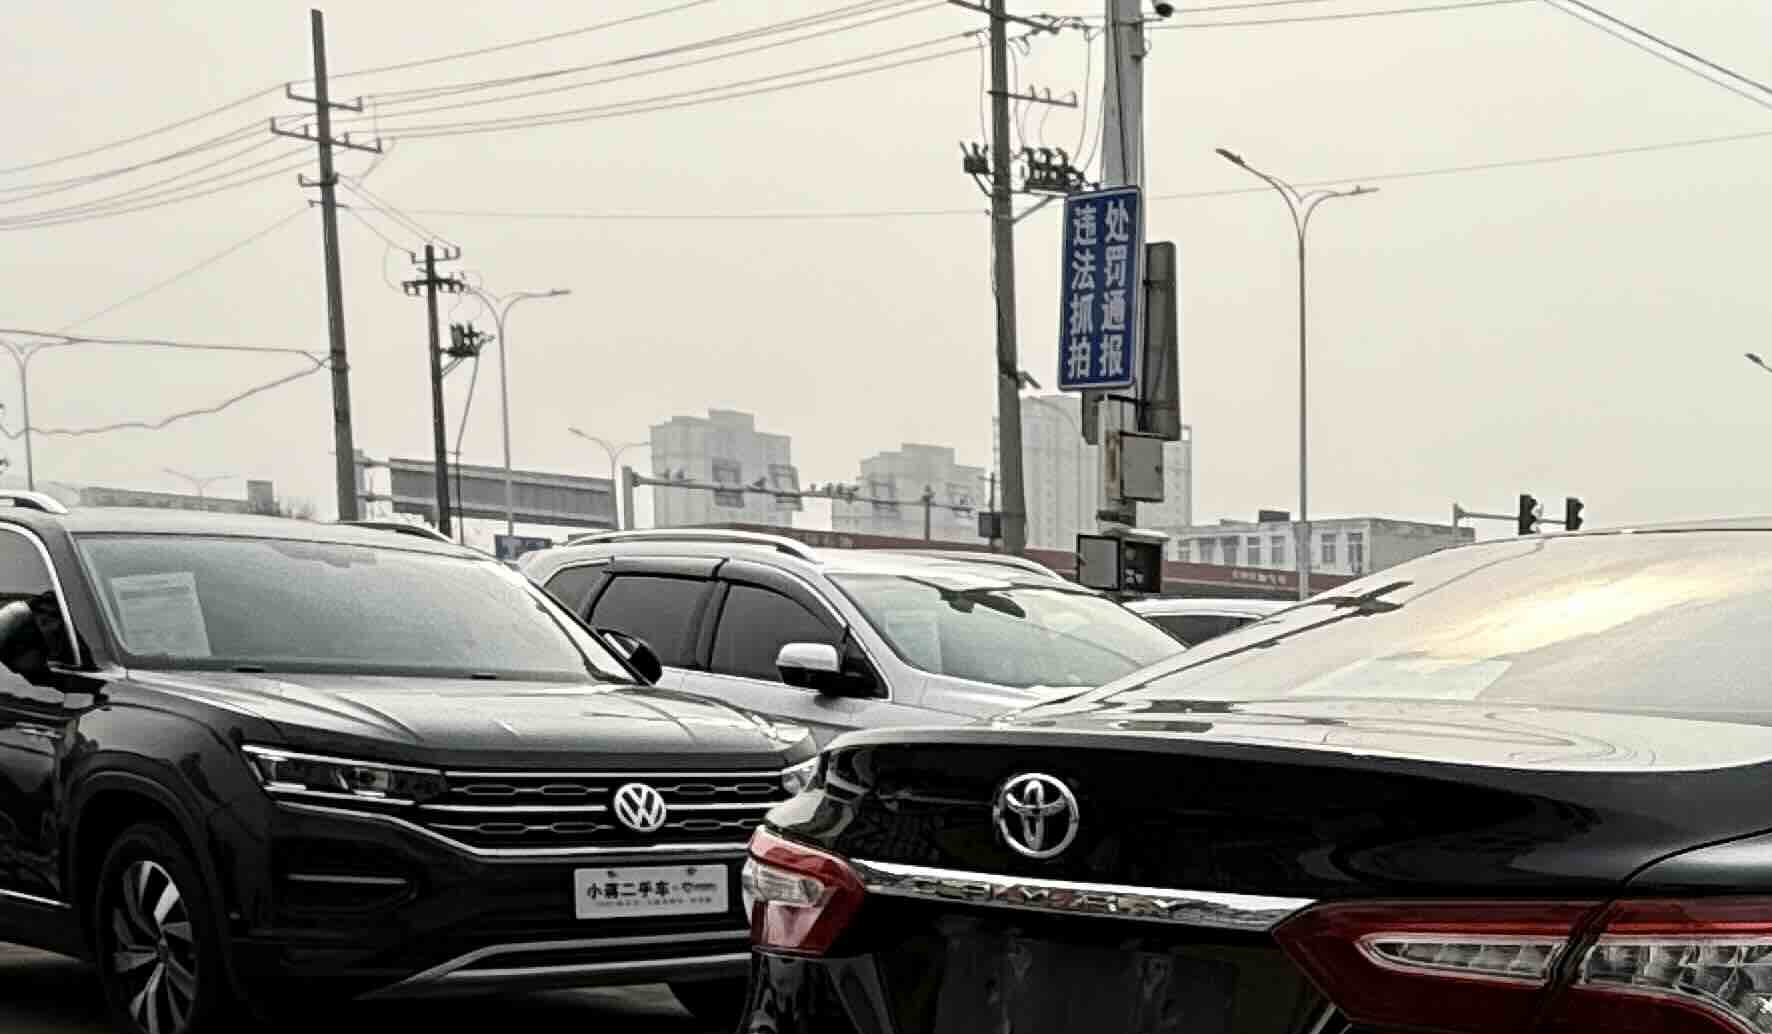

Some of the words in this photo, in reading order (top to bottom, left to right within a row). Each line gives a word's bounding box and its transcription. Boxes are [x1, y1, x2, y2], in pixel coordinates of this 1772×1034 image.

[1067, 204, 1097, 379] 违法抓拍
[1099, 200, 1129, 377] 处罚通报
